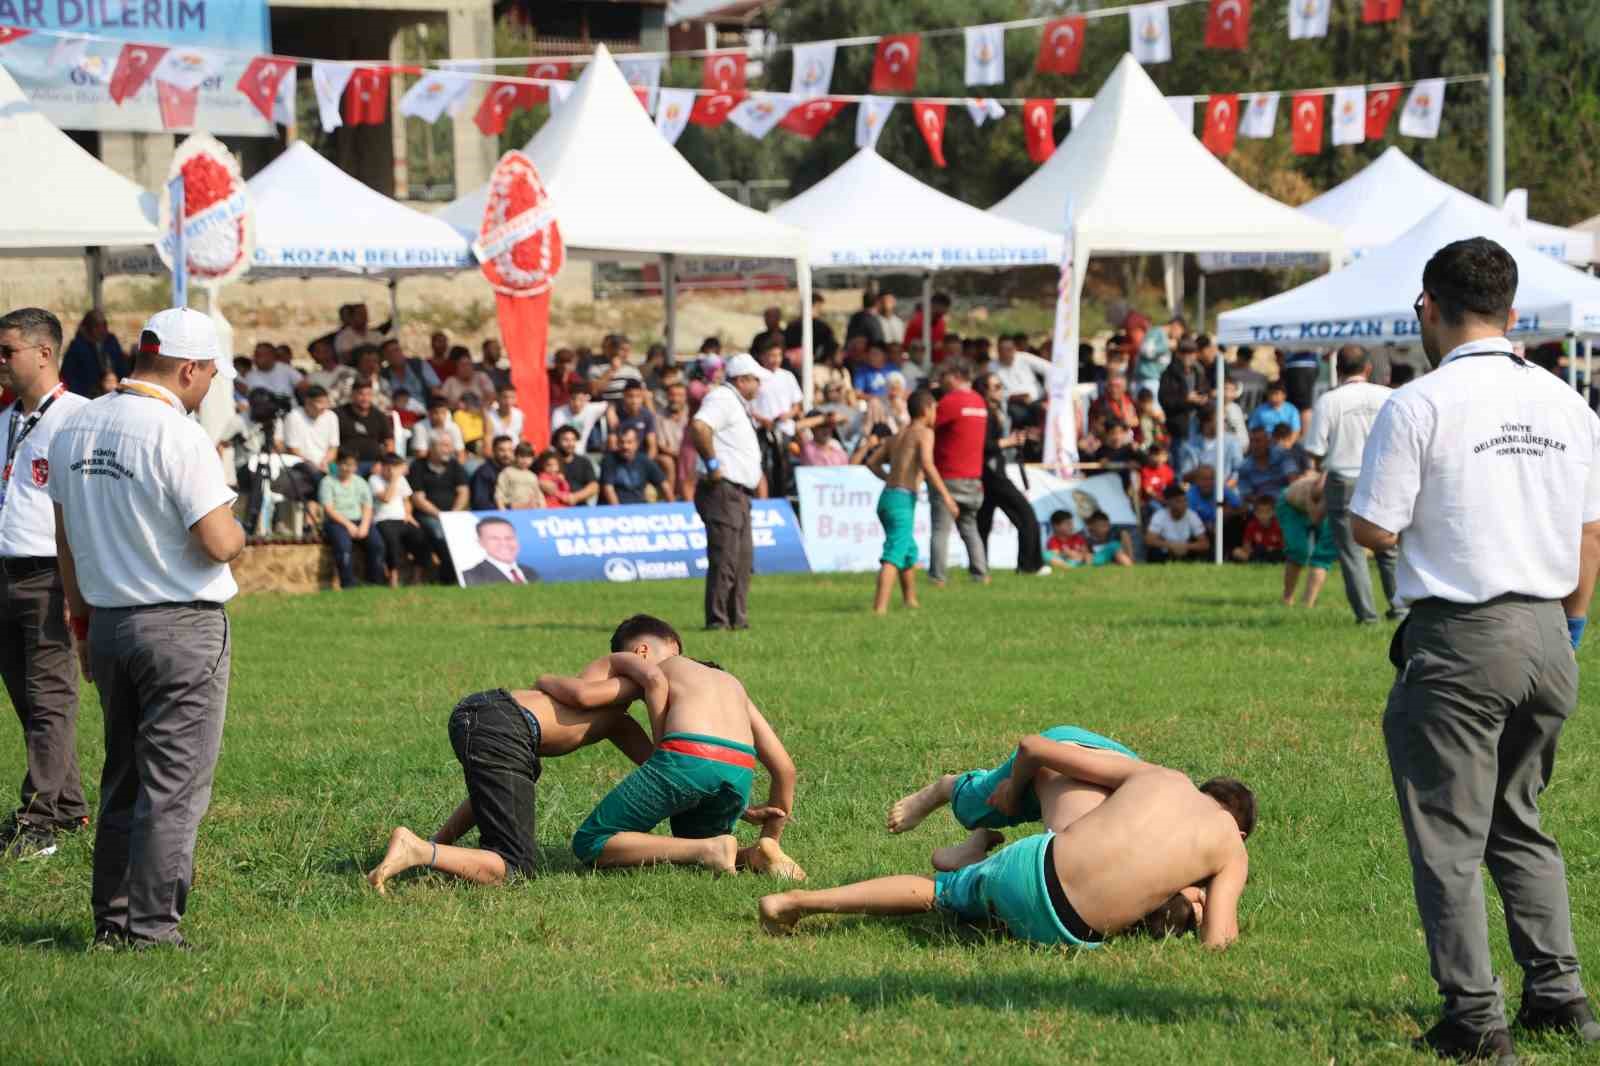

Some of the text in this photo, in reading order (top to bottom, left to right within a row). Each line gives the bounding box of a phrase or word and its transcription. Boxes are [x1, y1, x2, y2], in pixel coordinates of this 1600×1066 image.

[281, 246, 356, 263] KOZAN
[869, 248, 933, 263] KOZAN
[1250, 324, 1292, 341] T.C.
[1300, 319, 1383, 339] KOZAN
[814, 484, 872, 508] Tüm
[531, 515, 584, 538] TÜM
[554, 533, 689, 557] BAŞARILAR
